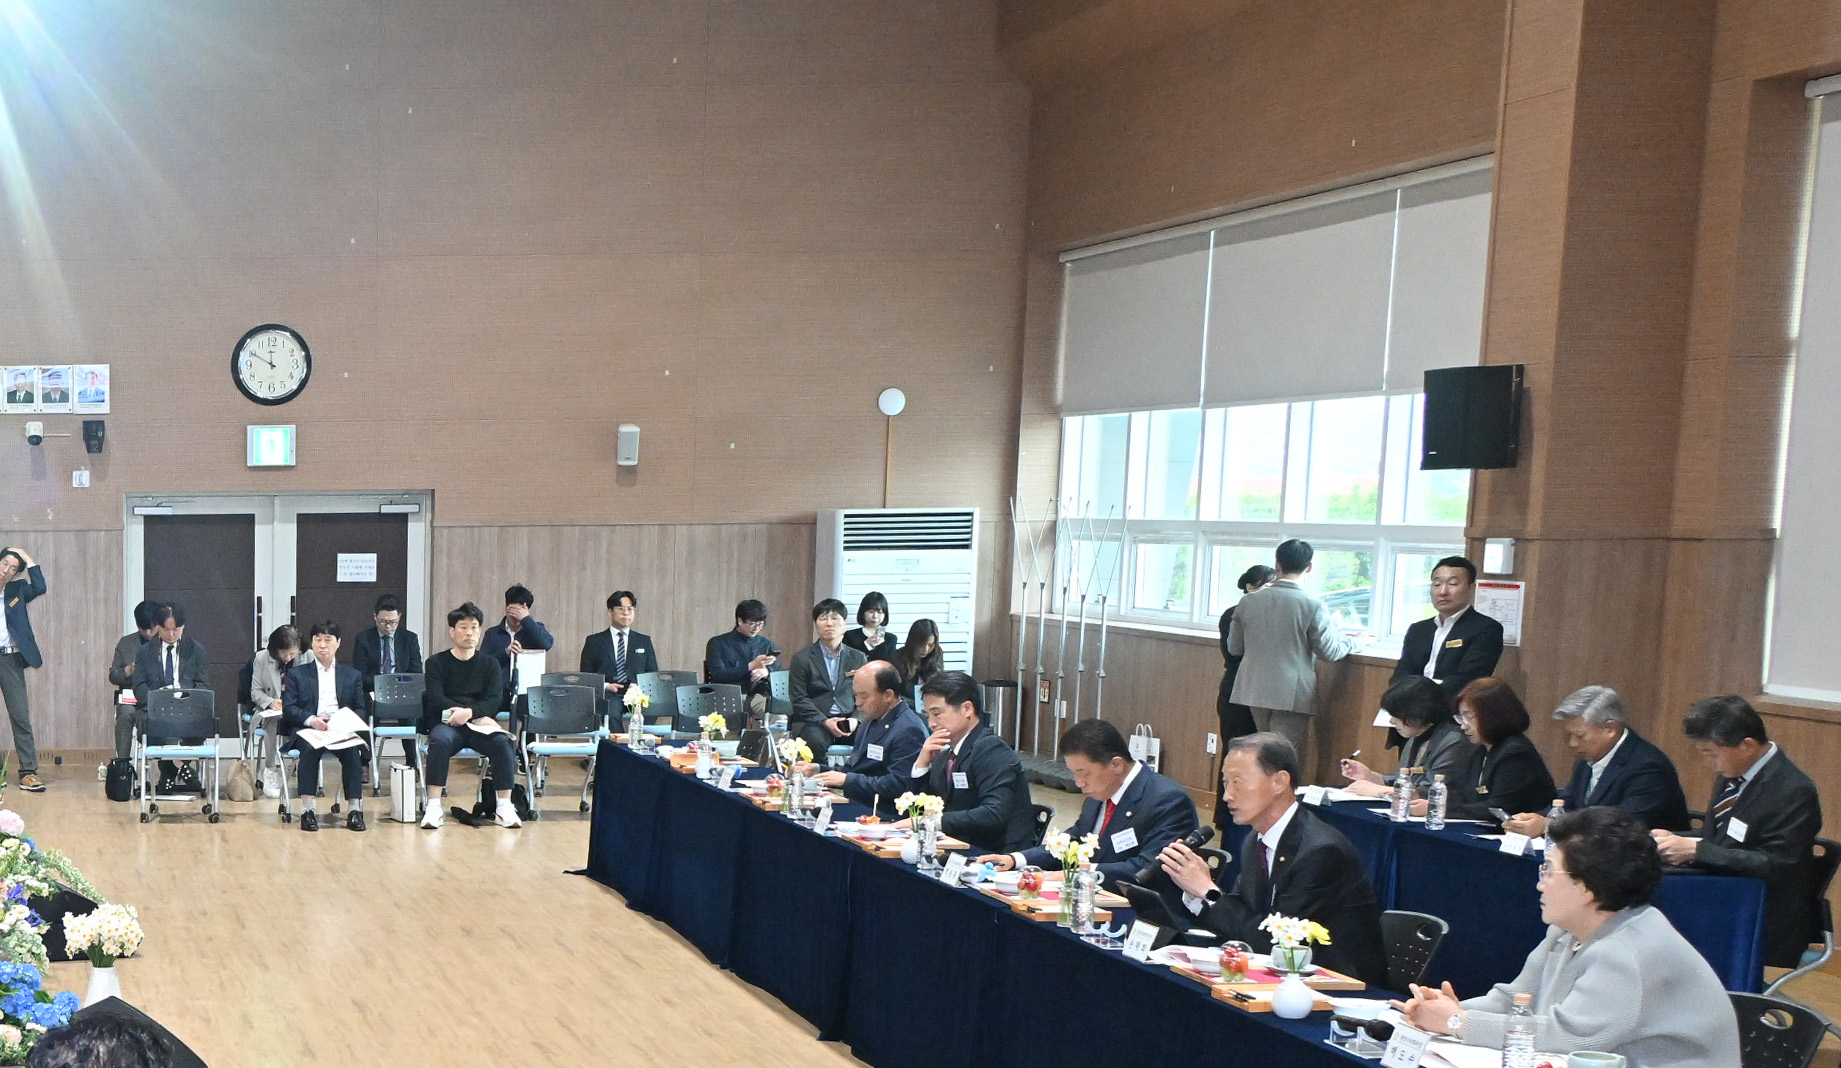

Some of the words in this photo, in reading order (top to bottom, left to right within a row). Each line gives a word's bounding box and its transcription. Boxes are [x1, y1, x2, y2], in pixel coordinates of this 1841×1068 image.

[258, 340, 264, 349] 11
[268, 337, 277, 347] 12
[289, 348, 295, 357] 2
[245, 360, 252, 370] 9
[292, 359, 299, 370] 3
[249, 372, 256, 381] 8
[288, 371, 294, 380] 4
[258, 381, 264, 389] 7
[268, 382, 276, 393] 6
[280, 381, 286, 389] 5
